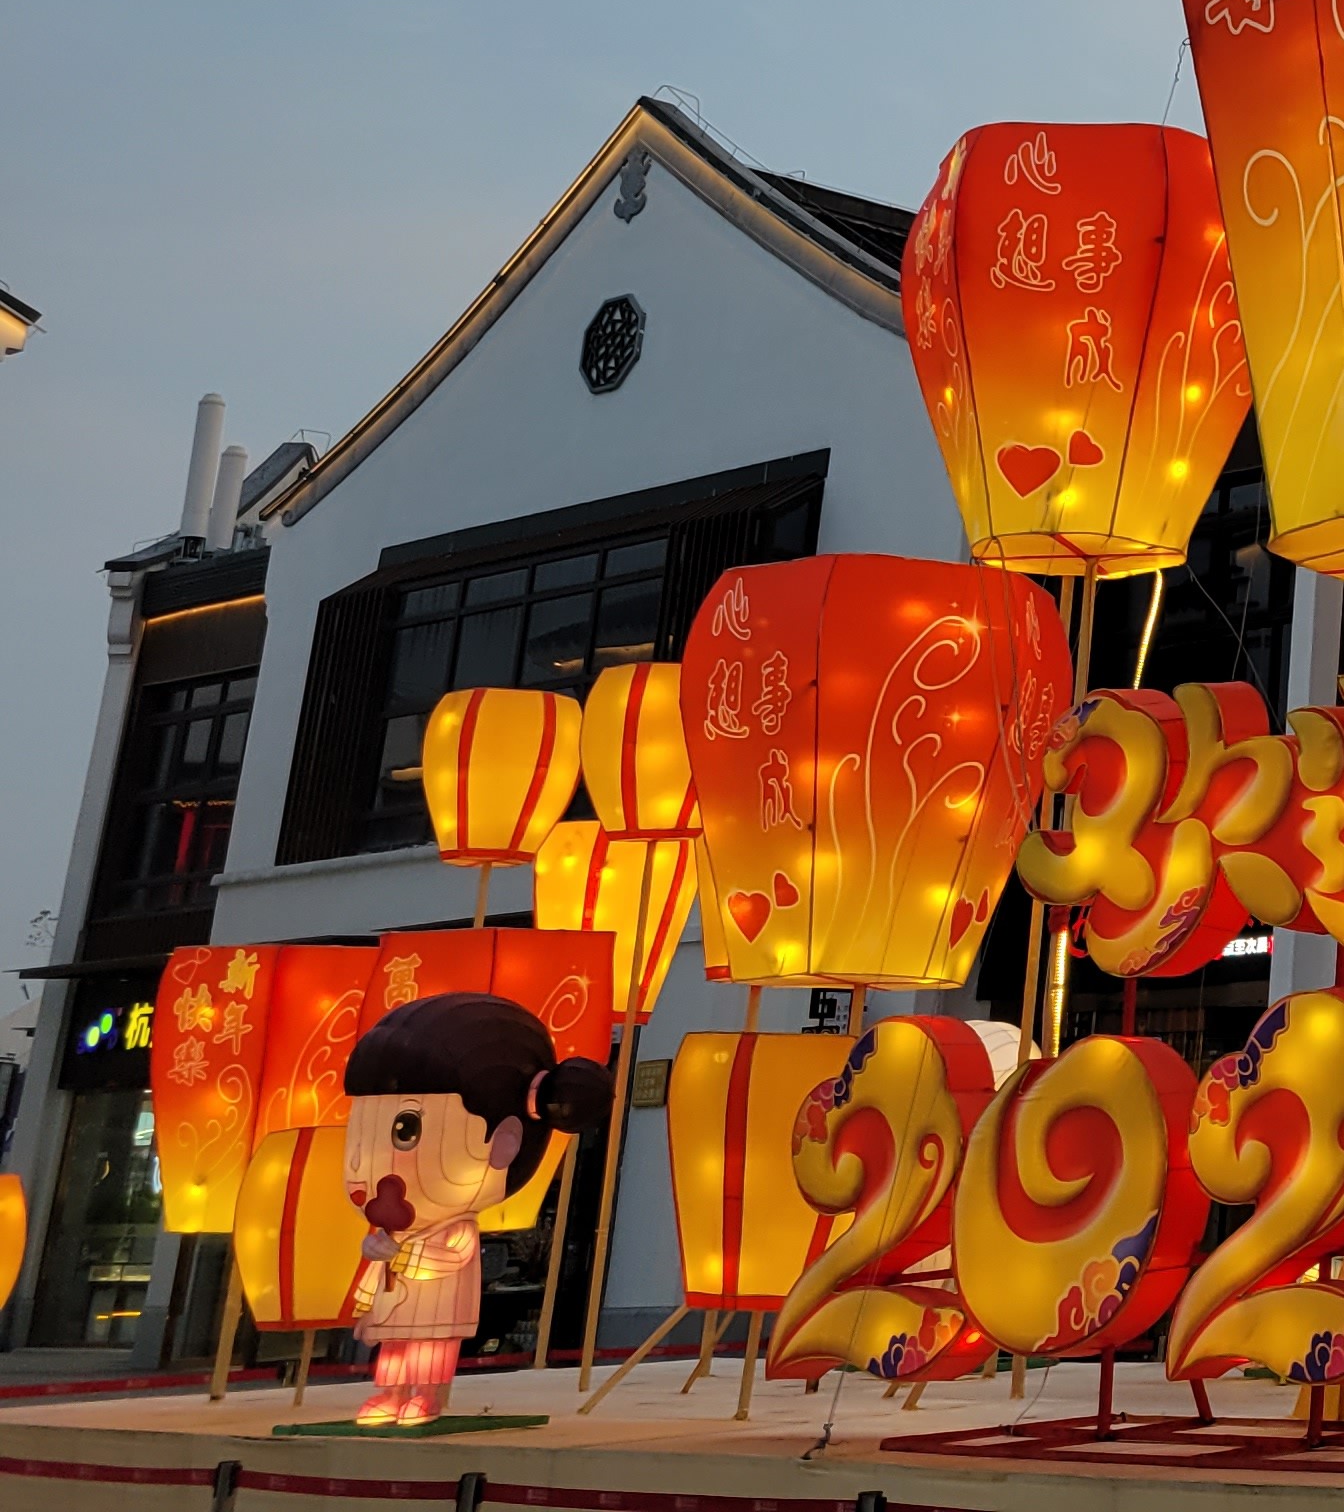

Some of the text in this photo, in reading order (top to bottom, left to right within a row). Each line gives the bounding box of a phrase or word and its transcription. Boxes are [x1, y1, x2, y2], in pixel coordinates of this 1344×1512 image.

[990, 131, 1062, 292] 心想
[1062, 211, 1123, 392] 事成
[703, 577, 752, 741] 心想
[752, 651, 802, 832] 事成
[213, 948, 260, 1055] 新年
